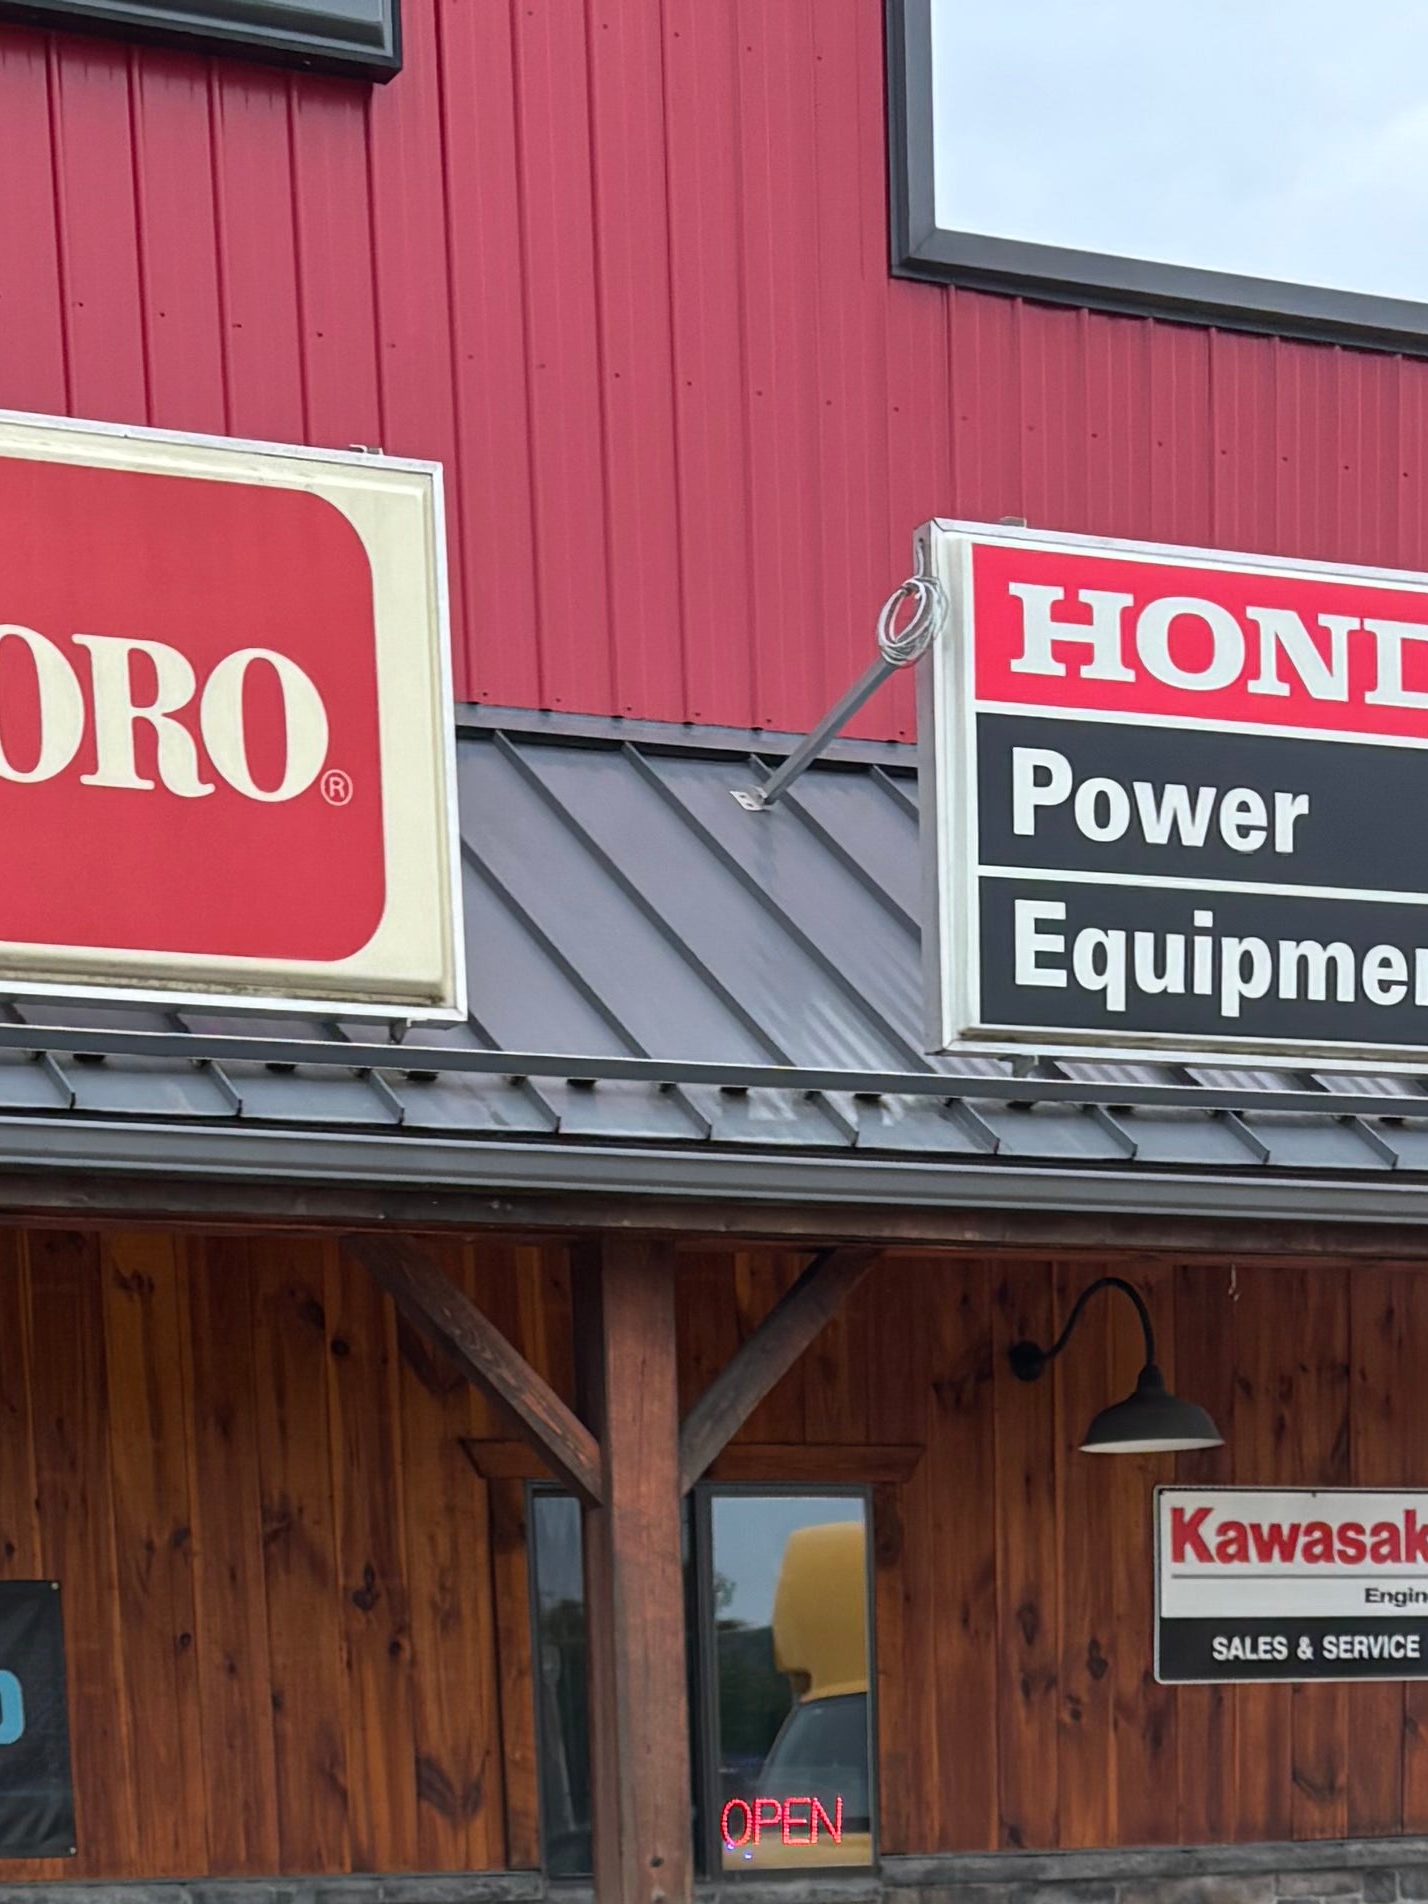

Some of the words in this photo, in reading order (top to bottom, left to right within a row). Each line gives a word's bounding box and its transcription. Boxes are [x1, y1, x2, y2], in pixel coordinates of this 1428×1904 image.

[1011, 746, 1310, 855] Power
[1212, 1636, 1288, 1661] SALES
[1296, 1638, 1314, 1661] &
[1322, 1635, 1421, 1660] SERVICE
[721, 1797, 844, 1847] OPEN
